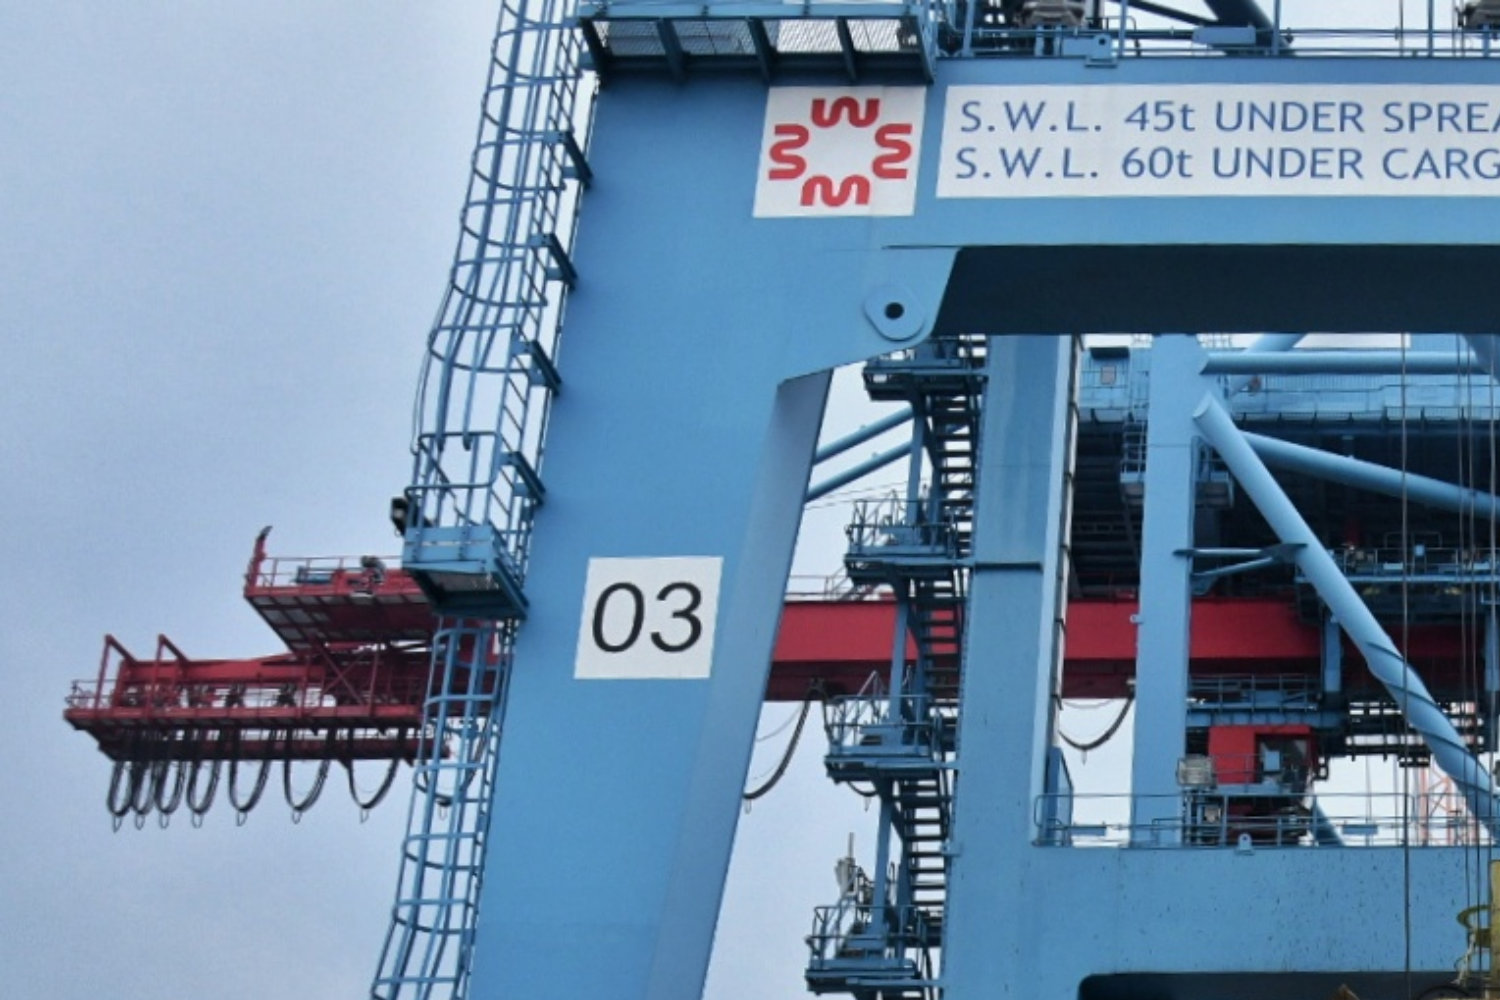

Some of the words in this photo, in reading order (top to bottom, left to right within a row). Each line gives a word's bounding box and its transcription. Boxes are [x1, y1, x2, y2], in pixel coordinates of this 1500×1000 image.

[960, 101, 1101, 132] S.W.L.
[1124, 101, 1196, 132] 45t
[1216, 101, 1364, 132] UNDER
[955, 147, 1099, 179] S.W.L.
[1122, 147, 1193, 178] 60t
[1213, 148, 1363, 179] UNDER
[592, 582, 702, 653] 03
